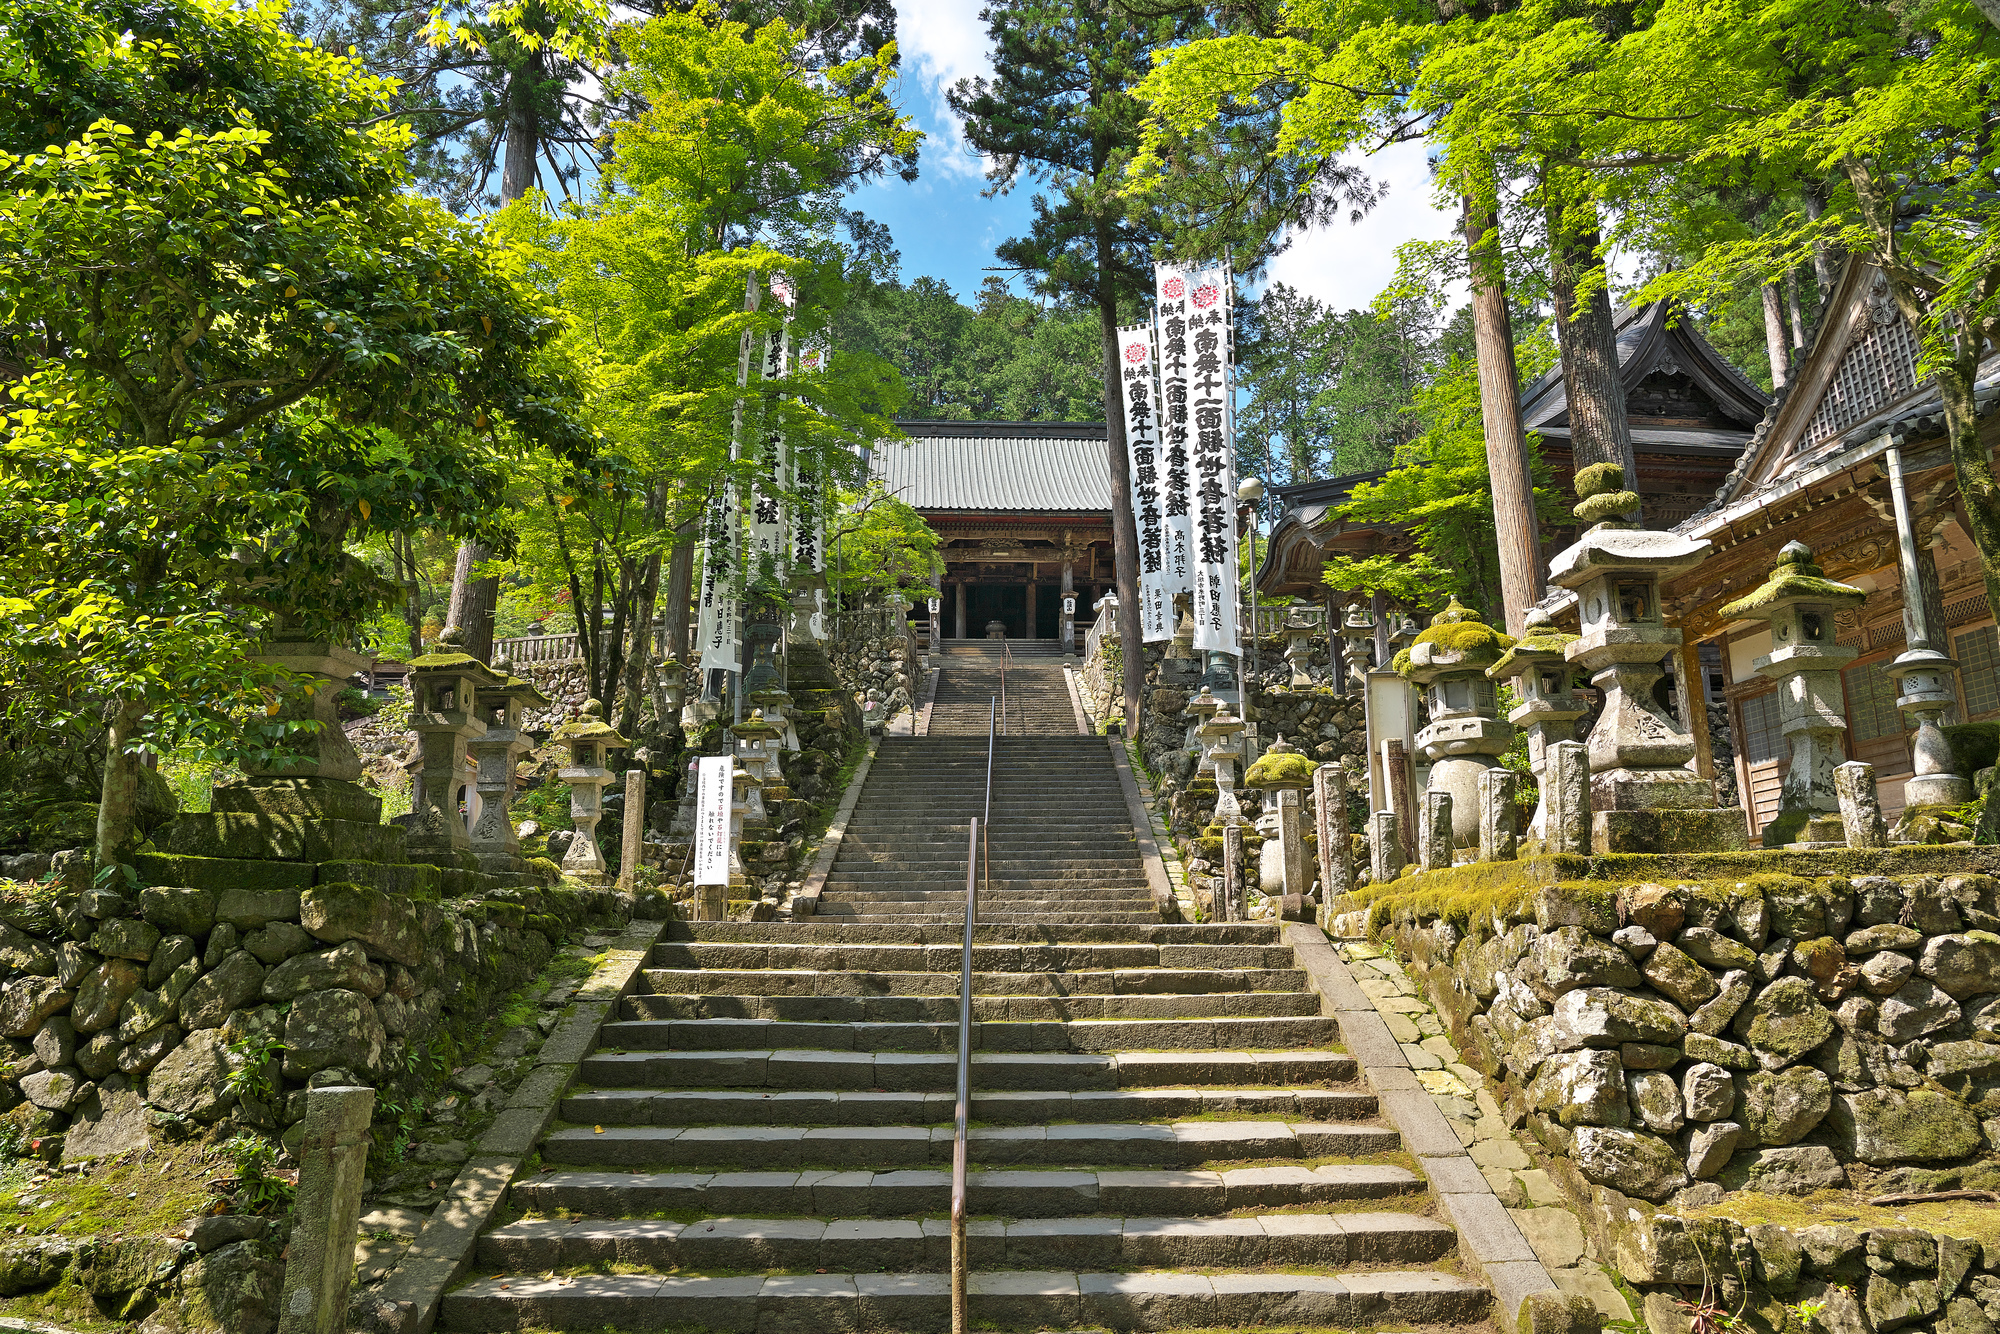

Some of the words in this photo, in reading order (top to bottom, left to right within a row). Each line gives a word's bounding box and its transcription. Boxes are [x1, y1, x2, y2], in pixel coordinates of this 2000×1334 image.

[706, 811, 715, 870] 触れないでください
